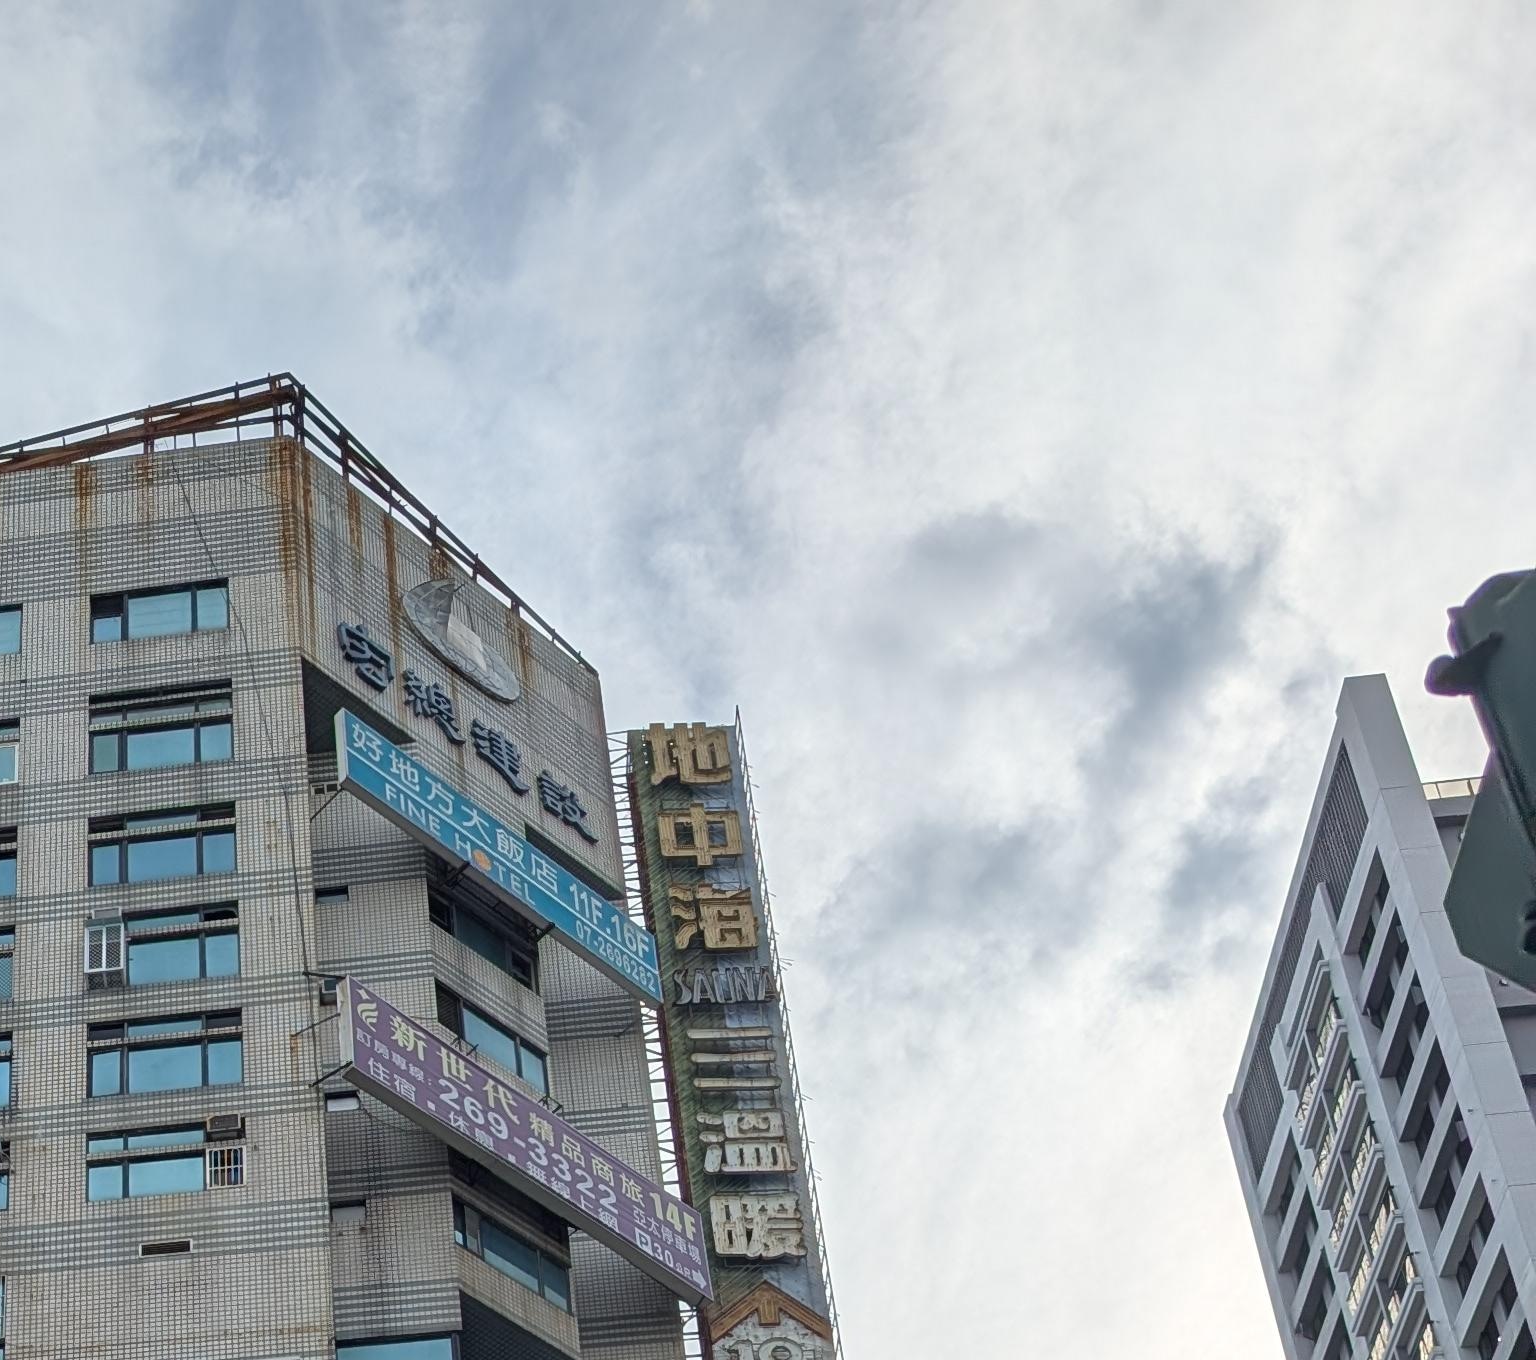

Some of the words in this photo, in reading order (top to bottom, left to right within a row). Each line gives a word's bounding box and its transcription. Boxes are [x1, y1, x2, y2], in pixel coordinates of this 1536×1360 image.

[351, 722, 558, 897] 好地方大飯店
[384, 781, 441, 837] FINE
[644, 722, 759, 950] 地中海
[670, 965, 778, 1005] SAUNA
[367, 1057, 417, 1103] 住宿
[389, 1014, 520, 1125] 新世代
[529, 1111, 645, 1209] 精品商旅
[649, 1191, 696, 1242] 14F
[437, 1078, 619, 1215] 269-3322
[686, 1026, 808, 1259] 三溫暖
